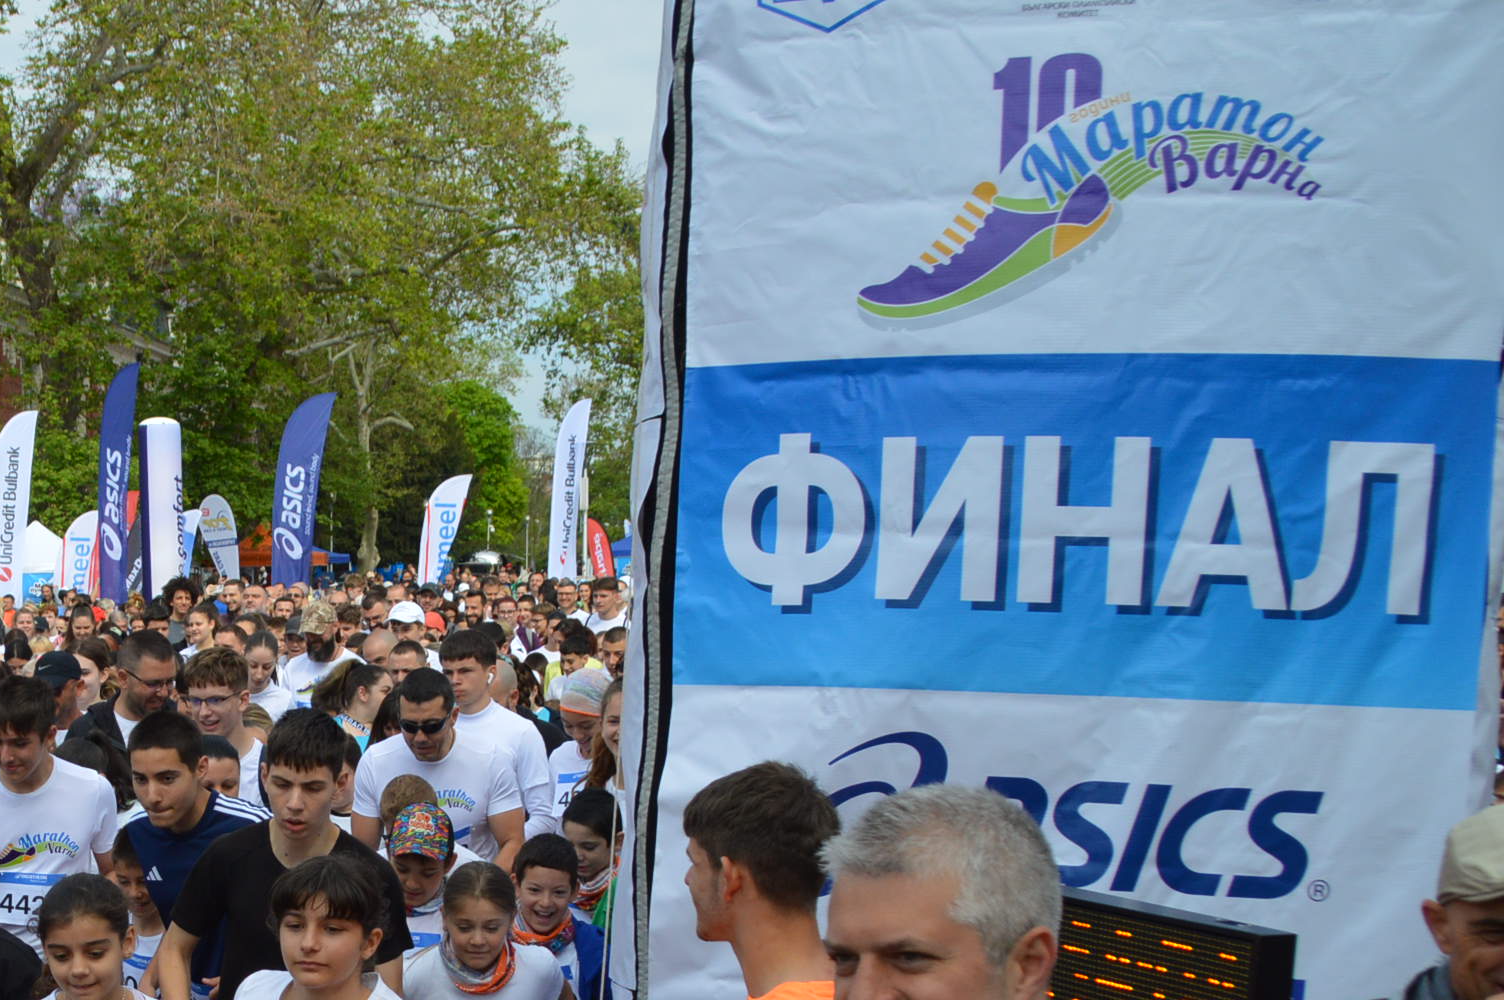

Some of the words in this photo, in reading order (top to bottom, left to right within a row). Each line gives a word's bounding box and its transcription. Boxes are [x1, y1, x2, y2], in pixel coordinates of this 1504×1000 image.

[993, 52, 1103, 174] 10
[1068, 91, 1132, 124] години
[1021, 92, 1325, 206] Маратон
[1148, 134, 1322, 201] Варна
[3, 446, 21, 501] Bulbank
[565, 434, 577, 488] Bulbank
[0, 503, 16, 565] UniCredit
[722, 432, 1444, 624] ФИНАЛ
[18, 832, 80, 852] Marathon
[0, 893, 45, 915] 442
